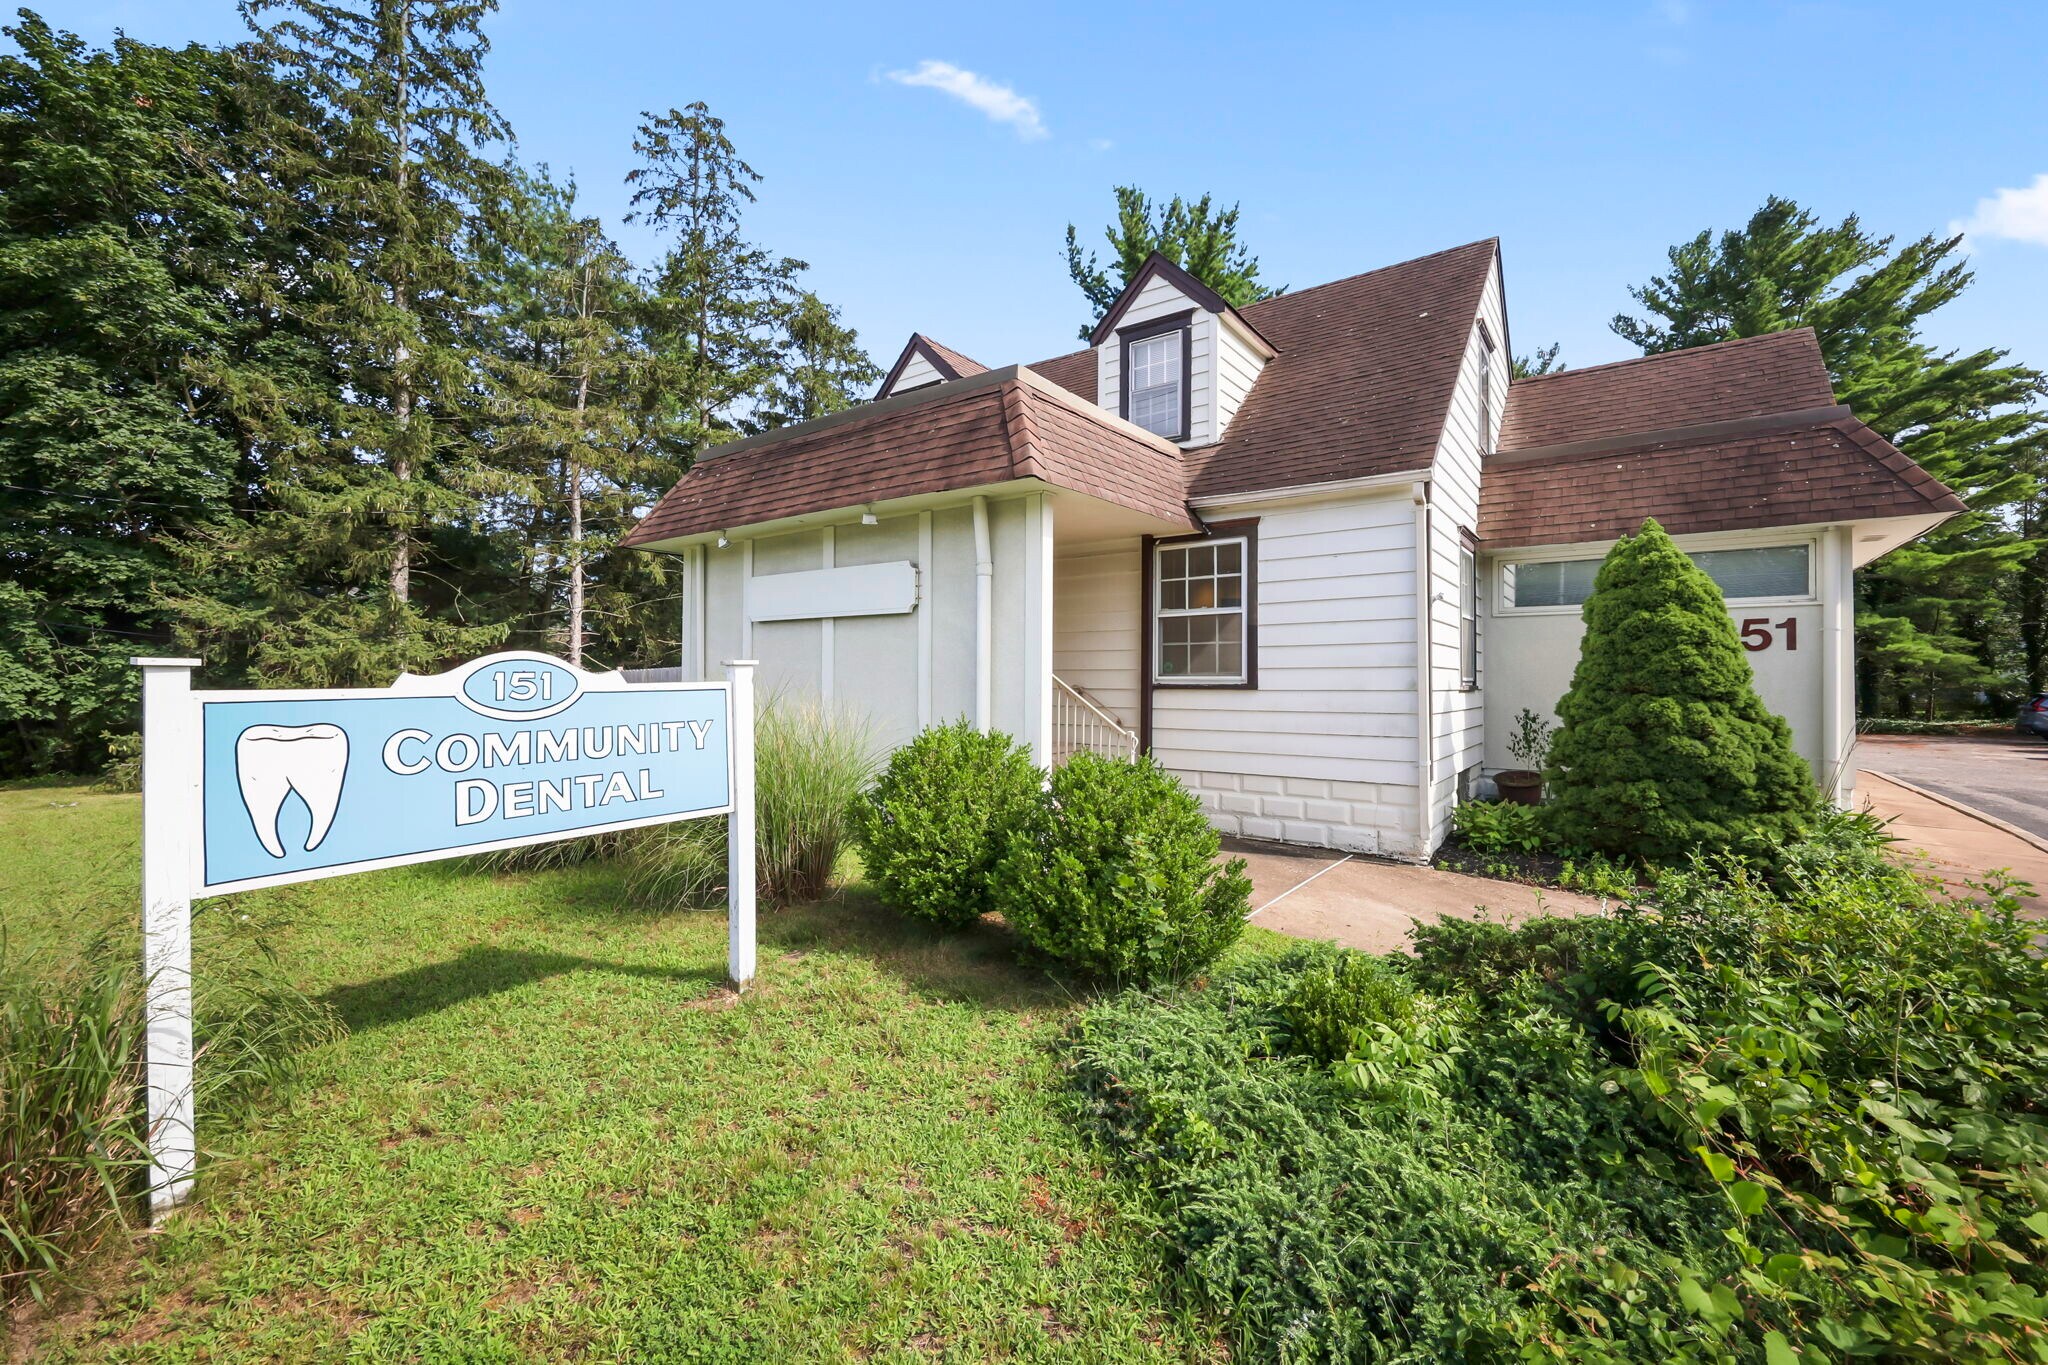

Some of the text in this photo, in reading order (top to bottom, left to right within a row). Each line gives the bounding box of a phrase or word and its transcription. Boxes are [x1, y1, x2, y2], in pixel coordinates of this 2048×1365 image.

[493, 671, 552, 701] 151
[382, 719, 713, 775] COMMUNITY
[454, 768, 664, 827] DENTAL
